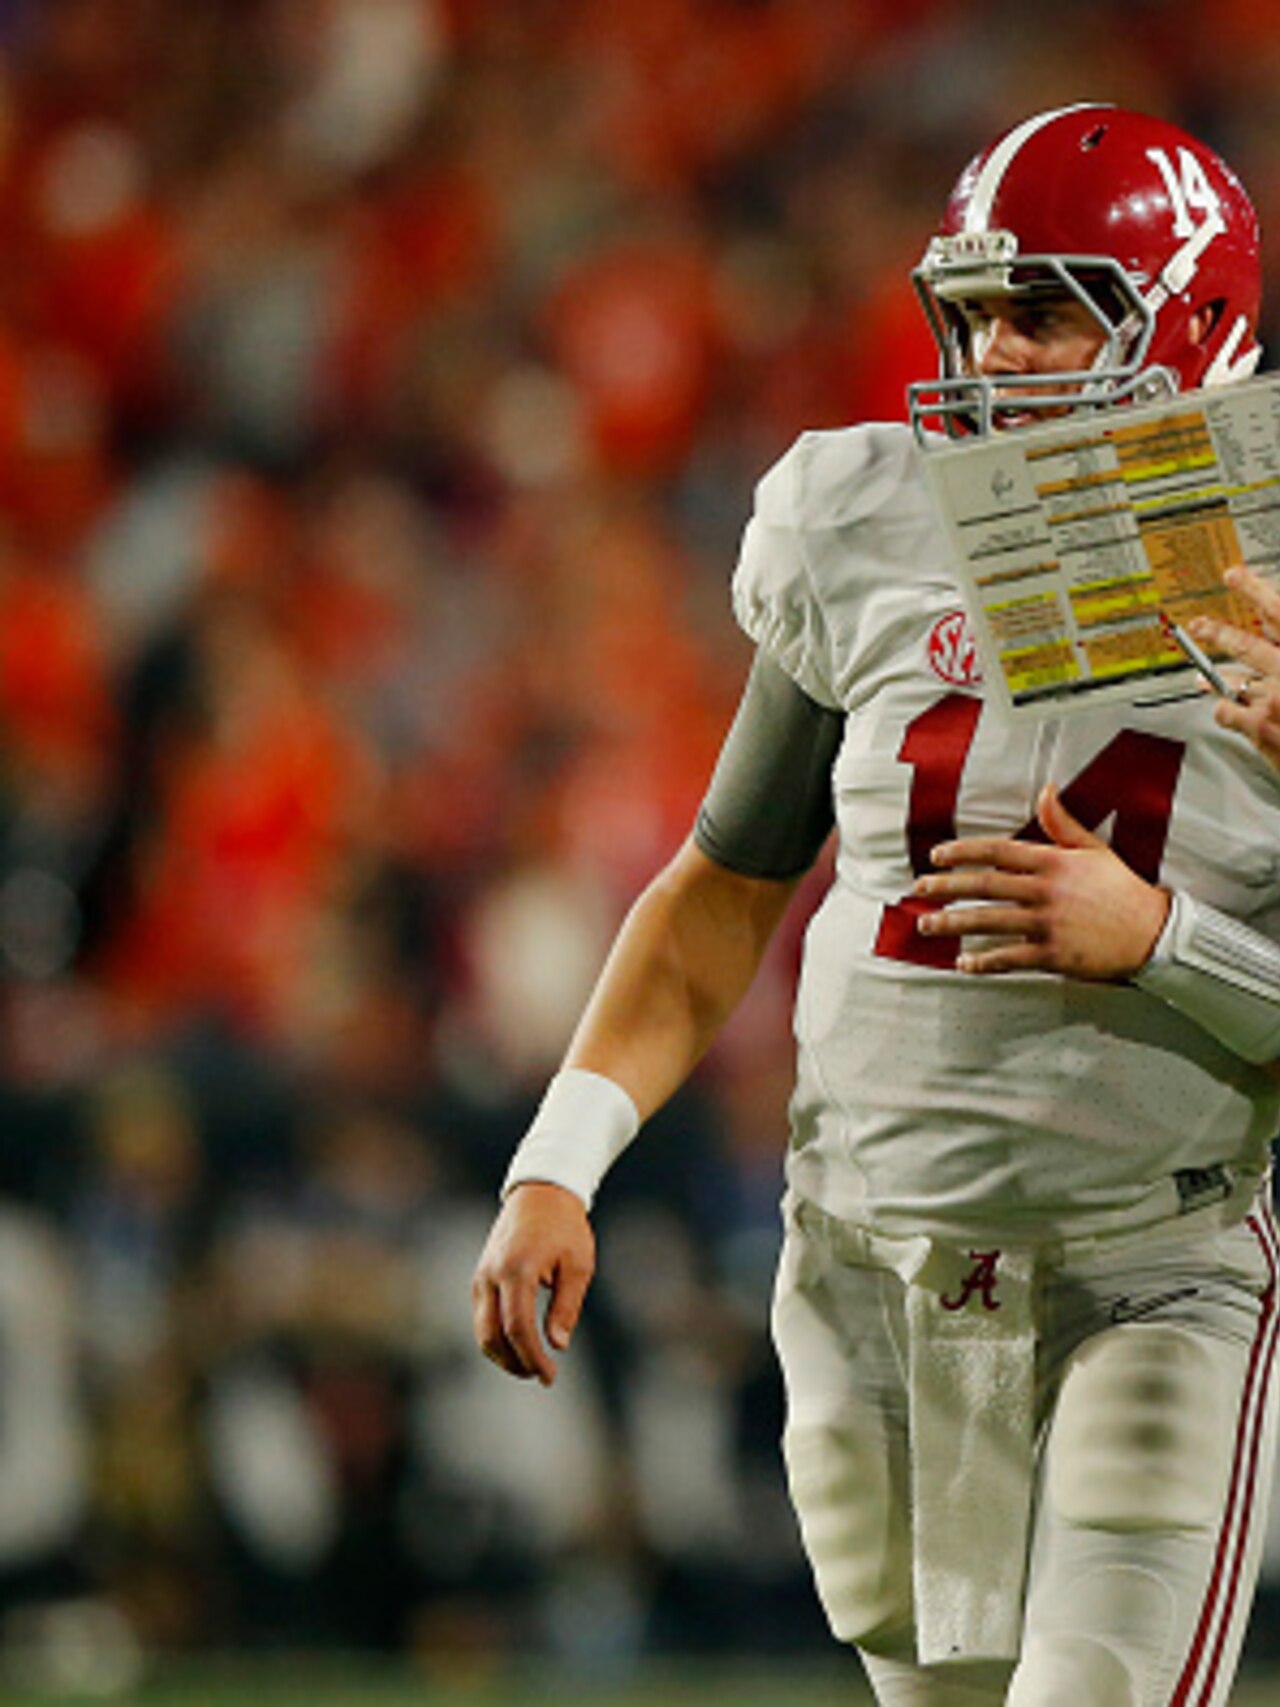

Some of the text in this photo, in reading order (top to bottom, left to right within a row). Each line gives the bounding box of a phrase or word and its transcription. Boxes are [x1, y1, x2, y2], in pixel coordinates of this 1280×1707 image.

[1145, 146, 1229, 239] 14
[873, 691, 1187, 971] 14
[939, 1250, 1002, 1312] A
